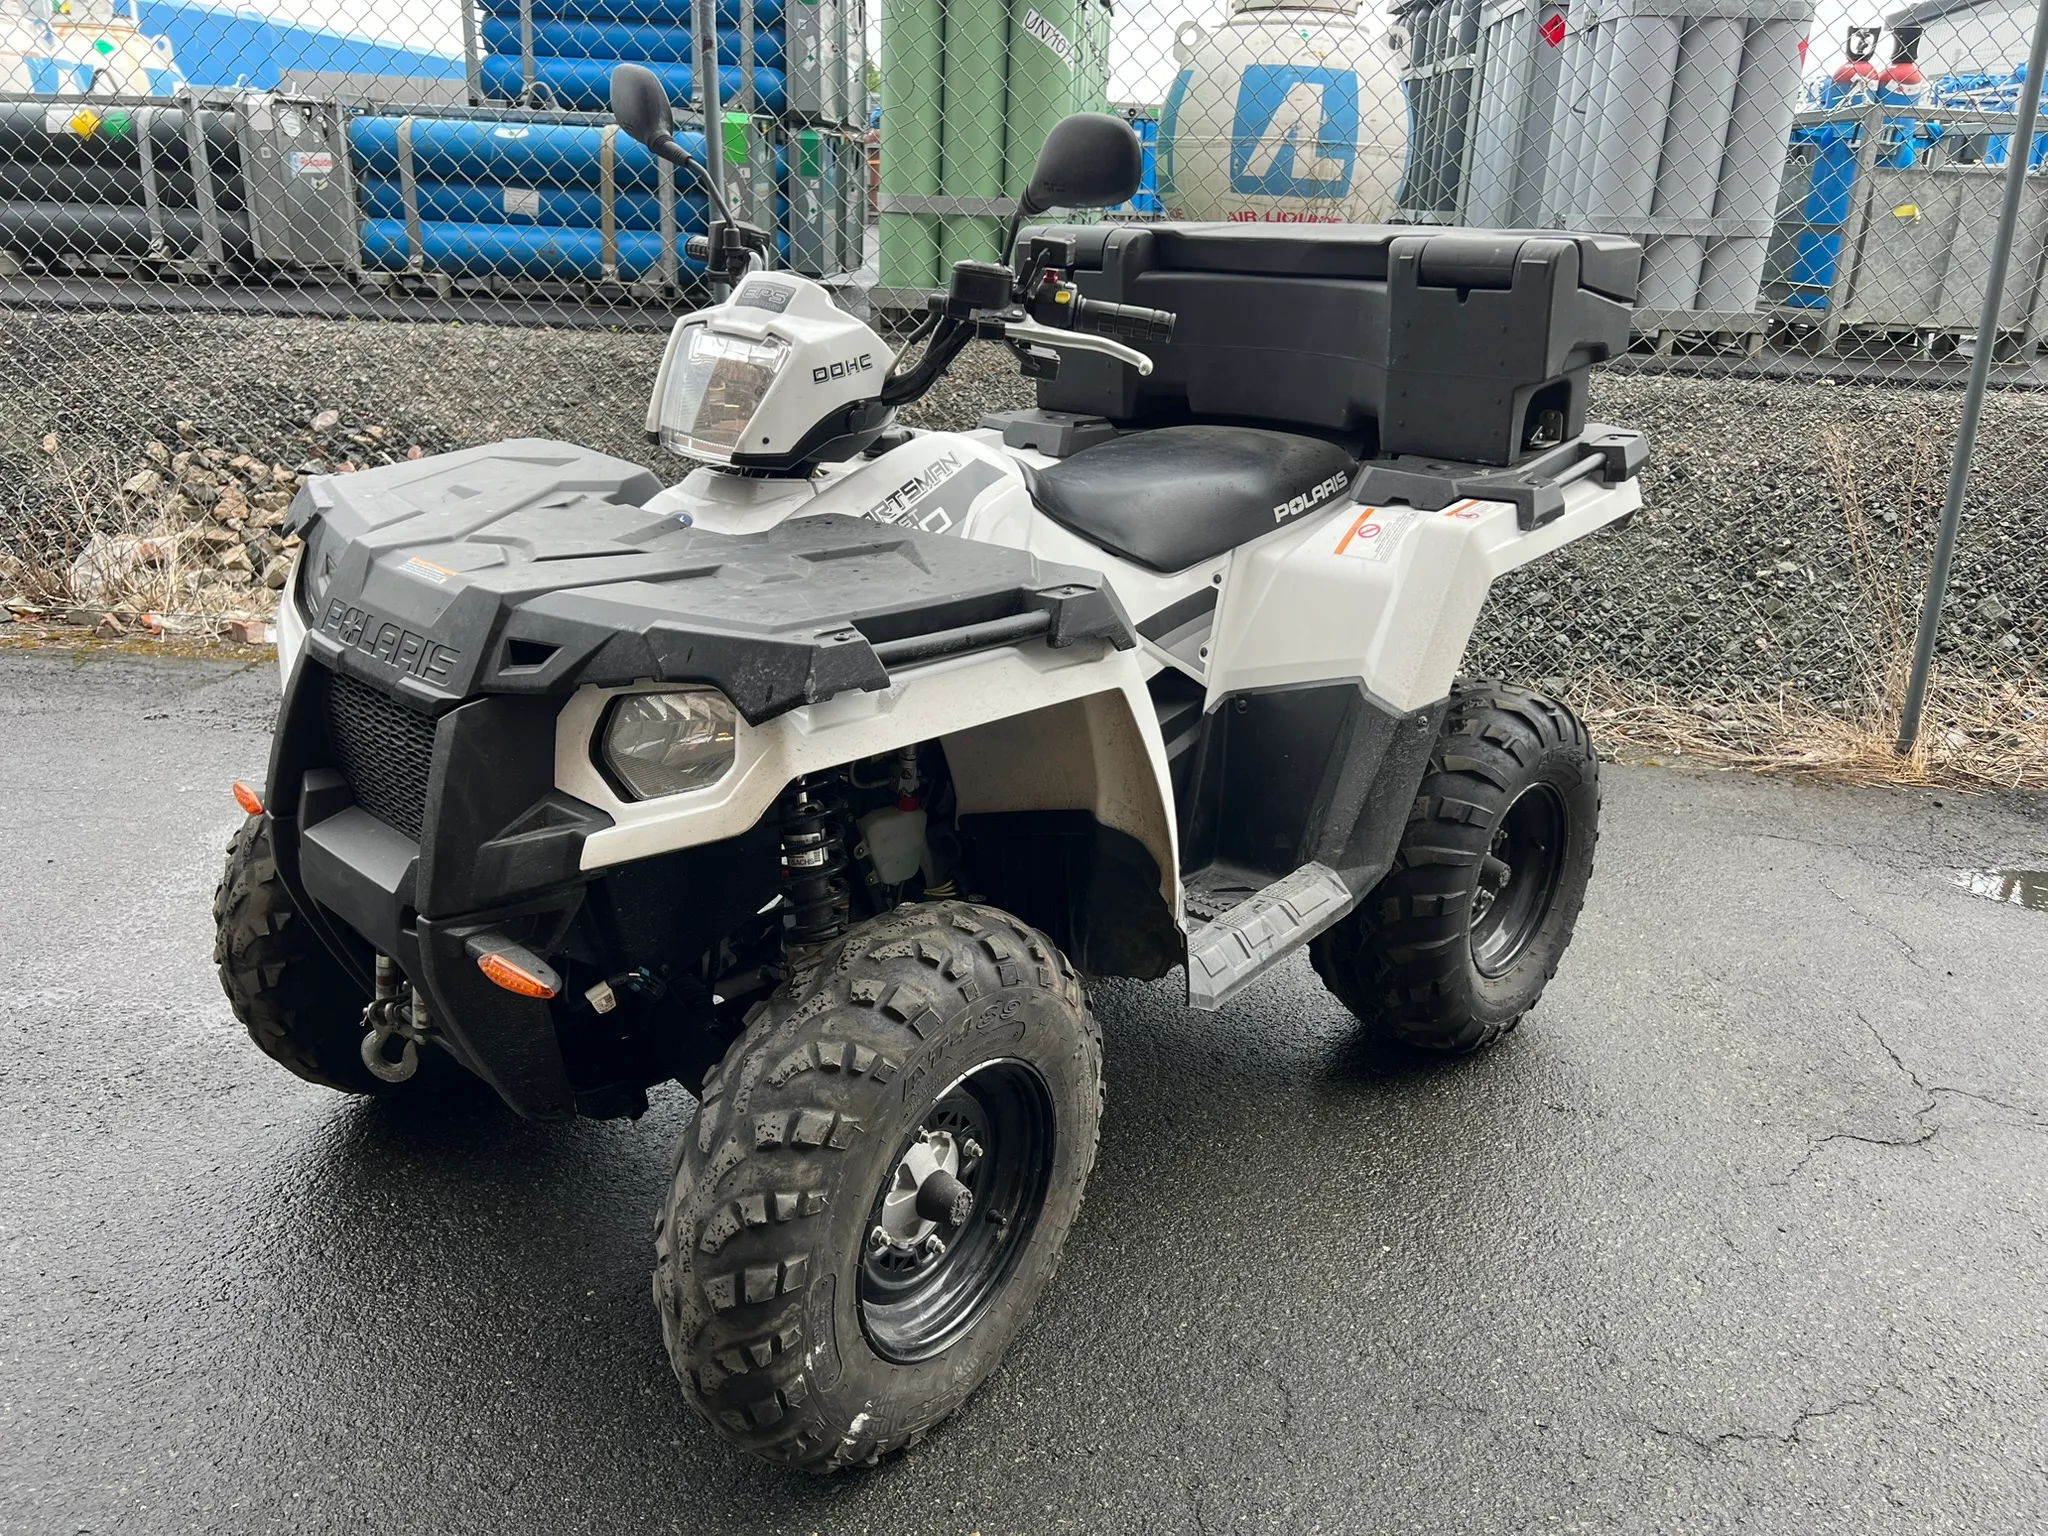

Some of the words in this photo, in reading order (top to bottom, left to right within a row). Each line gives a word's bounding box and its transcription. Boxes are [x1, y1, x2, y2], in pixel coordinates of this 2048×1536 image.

[741, 286, 789, 305] EPS
[813, 353, 873, 385] DOHC
[1273, 470, 1348, 523] POLARIS
[320, 597, 461, 687] POLARIS
